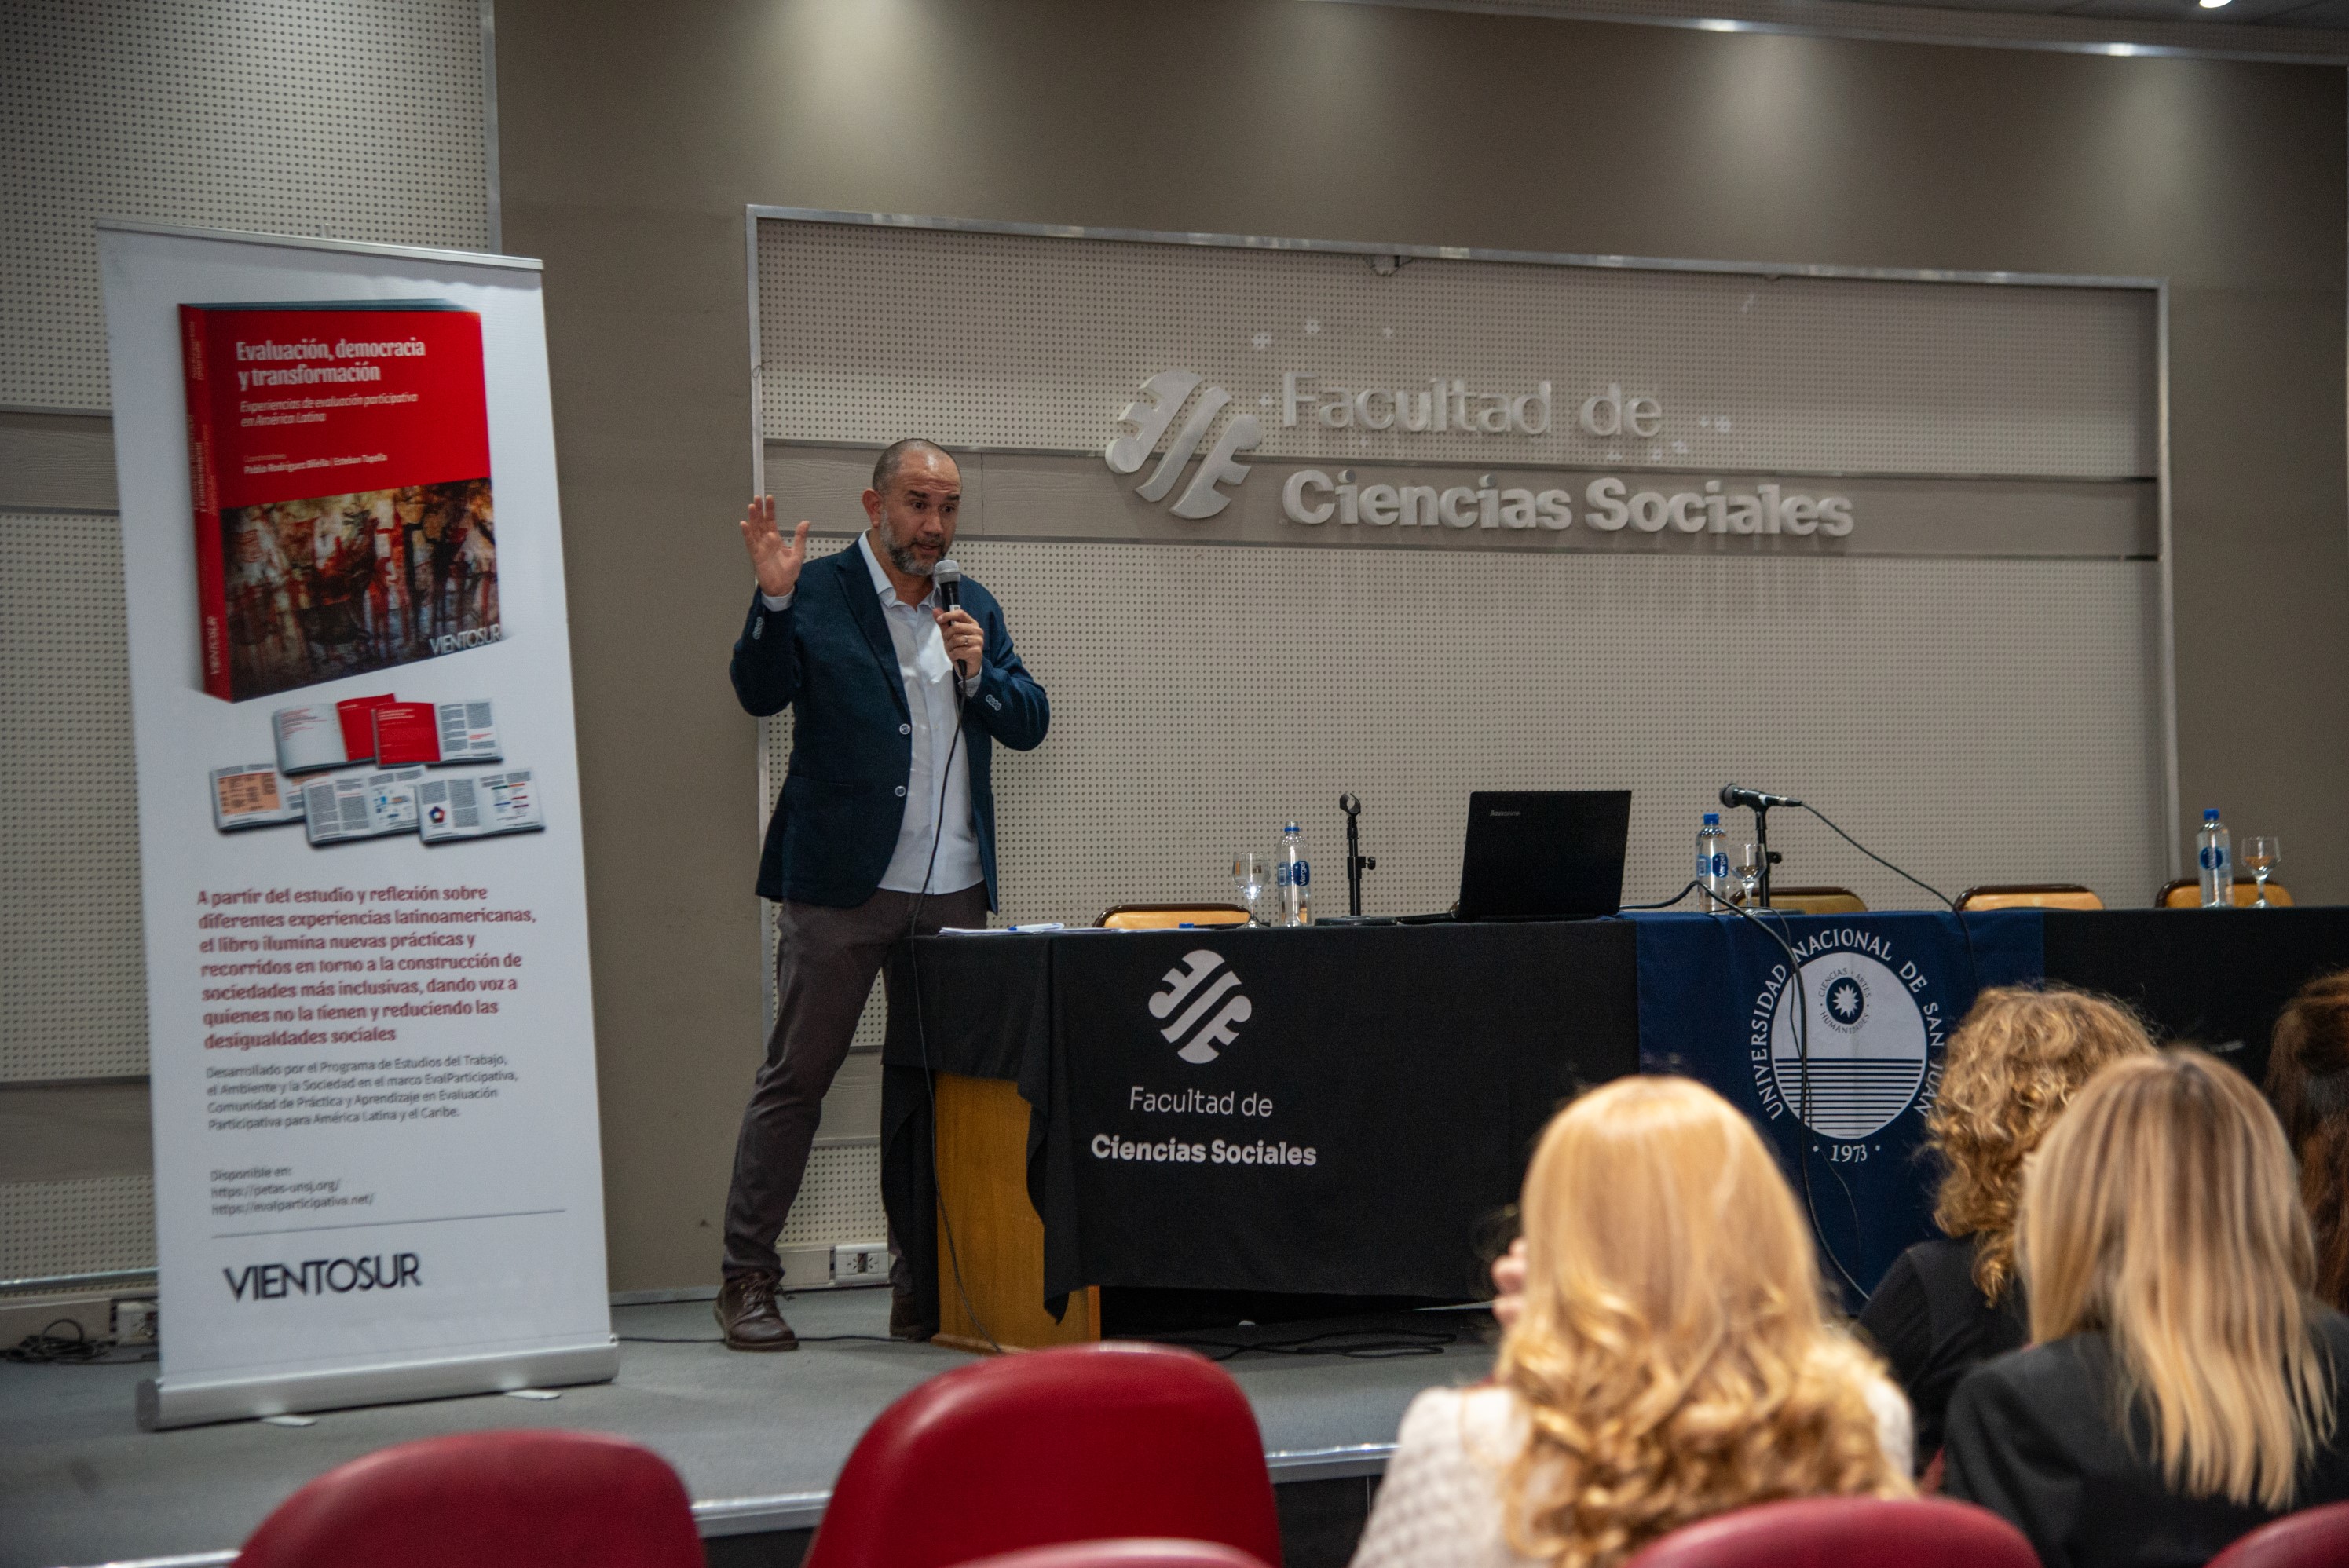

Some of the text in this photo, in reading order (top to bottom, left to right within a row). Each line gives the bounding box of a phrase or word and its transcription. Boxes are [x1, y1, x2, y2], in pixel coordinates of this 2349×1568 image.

[236, 337, 426, 361] Evaluación, democracia
[238, 362, 381, 391] y transformación
[240, 392, 419, 414] Experiencias de evaluación participativa
[1282, 371, 1663, 437] Facultad de
[240, 411, 327, 427] en América Latina
[1282, 469, 1853, 537] Ciencias Sociales
[430, 624, 502, 655] VIENTOSUR
[1299, 861, 1308, 886] Vergel
[197, 886, 487, 908] A partir del estudio y reflexión sobre
[199, 908, 536, 930] diferentes experiencias latinoamericanas,
[199, 932, 476, 953] el libro ilumina nuevas prácticas y
[201, 953, 521, 977] recorridos en torno a la construcción de
[202, 978, 518, 1001] sociedades más inclusivas, dando voz a
[1818, 967, 1871, 998] CIENCIAS ARTES
[203, 1000, 499, 1028] quienes no la tienen y reduciendo las
[1751, 928, 1945, 1120] UNIVERSIDAD NACIONAL DE SAN JUAN
[204, 1027, 396, 1051] desigualdades sociales
[207, 1064, 282, 1079] Desarrollado
[284, 1065, 304, 1076] por
[307, 1062, 317, 1073] el
[320, 1060, 375, 1074] Programa
[378, 1059, 391, 1069] de
[394, 1058, 441, 1069] Estudios
[444, 1056, 460, 1066] del
[207, 1085, 217, 1096] el
[220, 1083, 276, 1095] Ambiente
[279, 1084, 286, 1095] y
[289, 1080, 299, 1091] la
[302, 1078, 356, 1091] Sociedad
[358, 1079, 371, 1088] en
[375, 1076, 384, 1087] el
[387, 1076, 422, 1086] marco
[207, 1099, 276, 1113] Comunidad
[279, 1098, 294, 1109] de
[344, 1098, 352, 1108] y
[354, 1092, 420, 1107] Aprendizaje
[423, 1092, 436, 1102] en
[439, 1087, 497, 1101] Evaluación
[1129, 1086, 1273, 1117] Facultad de
[208, 1117, 282, 1130] Participativa
[284, 1117, 311, 1129] para
[314, 1112, 359, 1124] América
[362, 1109, 397, 1122] Latina
[399, 1112, 406, 1122] y
[408, 1109, 418, 1119] el
[1091, 1134, 1317, 1166] Ciencias Sociales
[1830, 1144, 1868, 1163] 1973
[210, 1167, 272, 1182] Disponible
[223, 1252, 423, 1302] VIENTOSUR
